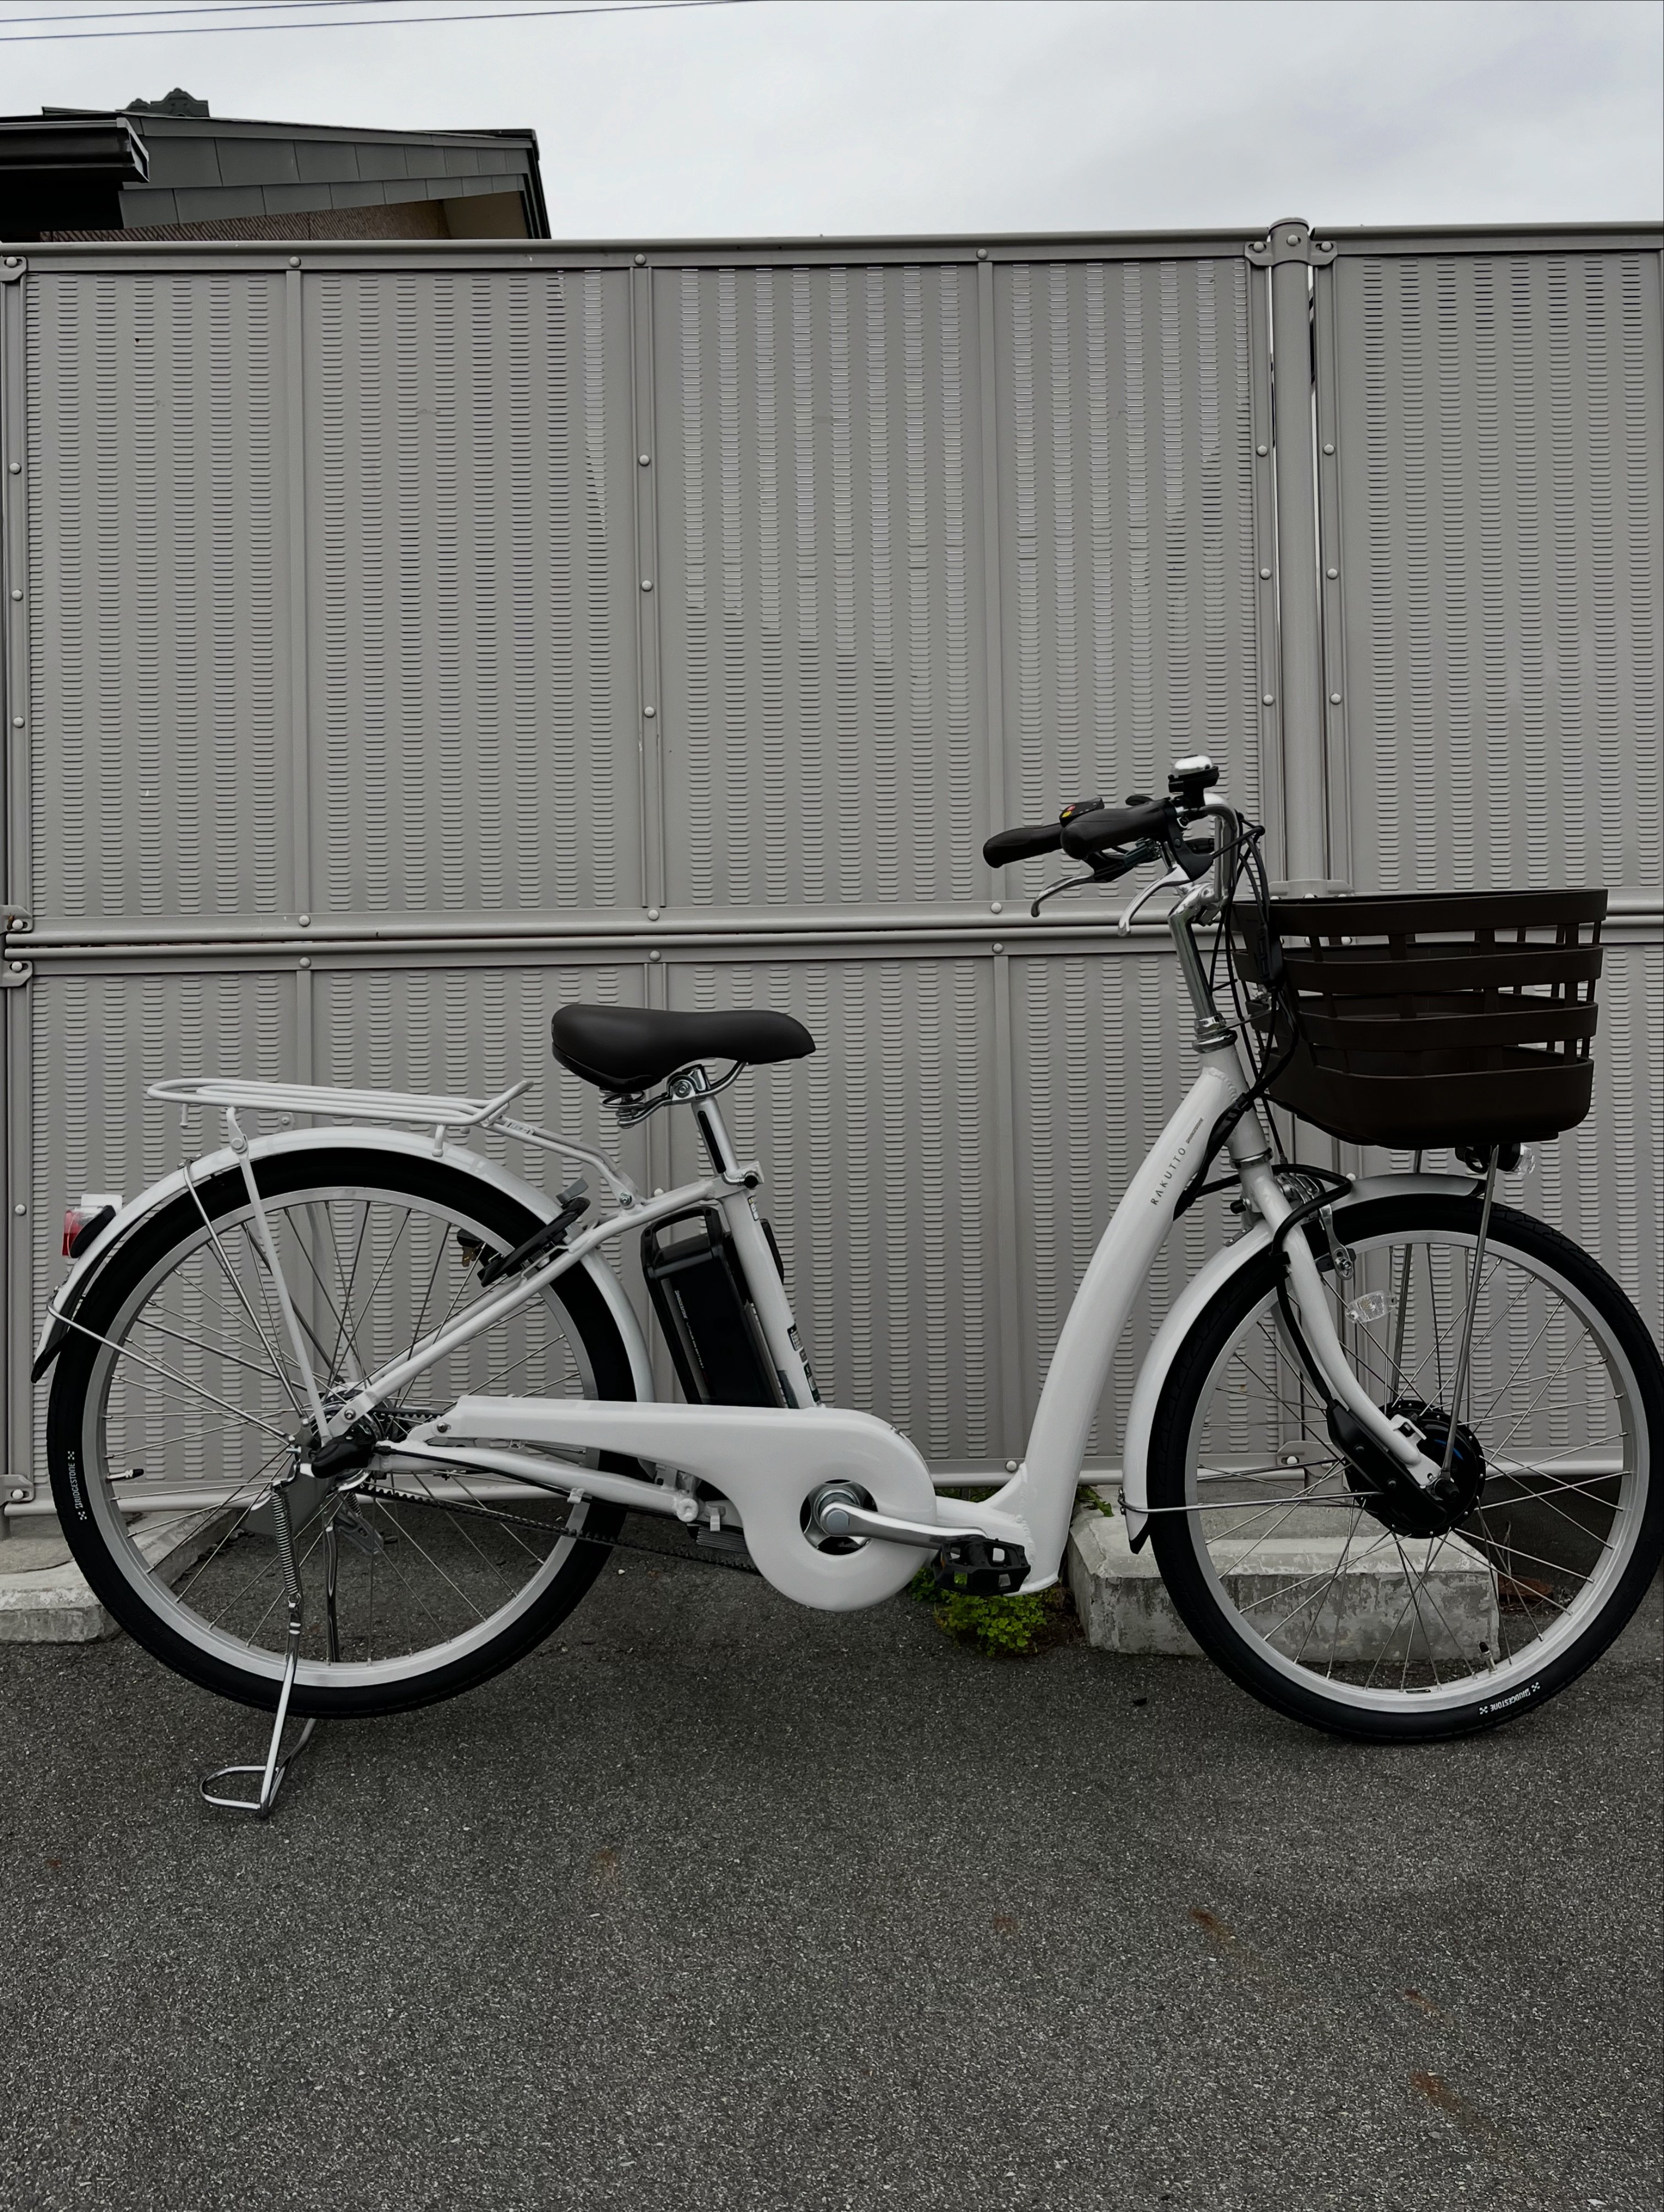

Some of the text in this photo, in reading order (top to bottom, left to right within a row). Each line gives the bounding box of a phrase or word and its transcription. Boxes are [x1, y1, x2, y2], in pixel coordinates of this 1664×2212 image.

[1150, 1148, 1186, 1205] RAKUTTO
[68, 1463, 84, 1510] BRIDGESTONE
[1490, 1687, 1531, 1712] BRIDGESTONE
